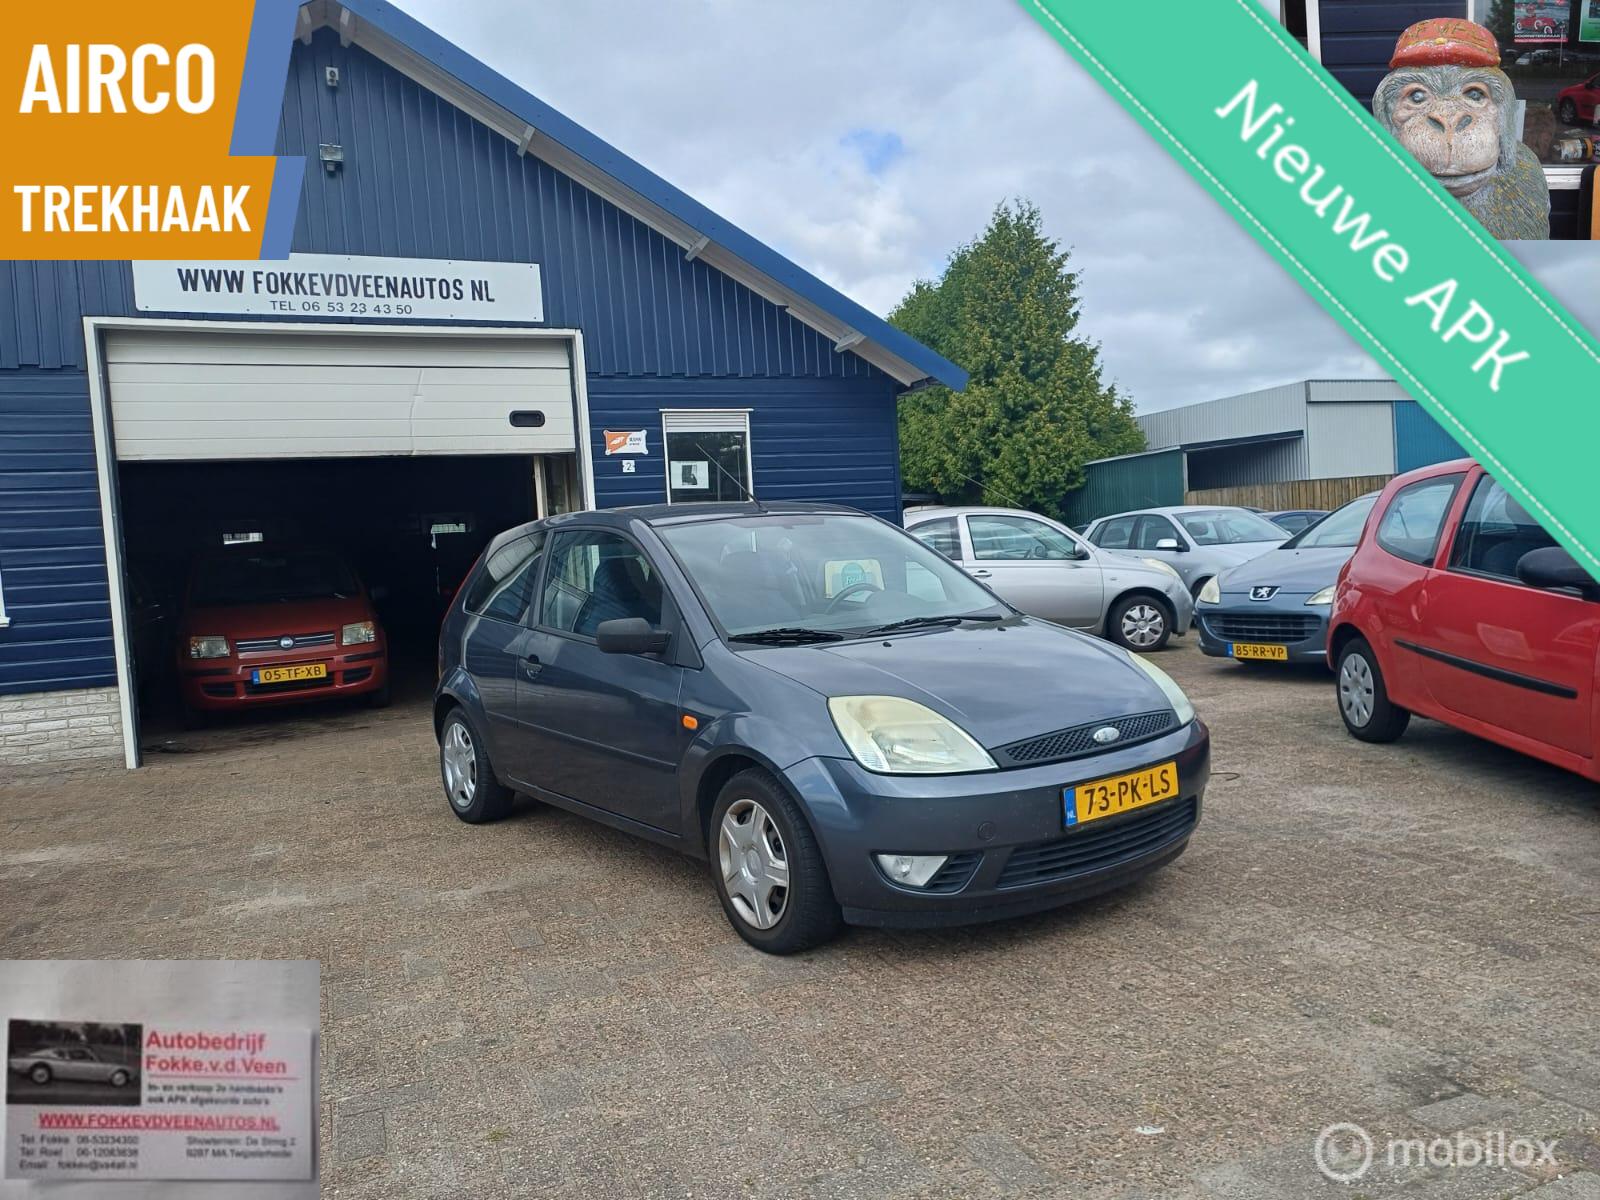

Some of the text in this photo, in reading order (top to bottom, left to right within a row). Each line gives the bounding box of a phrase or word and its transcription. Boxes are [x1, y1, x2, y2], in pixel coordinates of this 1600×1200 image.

[177, 268, 496, 303] WWW FOKKEVDVEENAUTOS NL
[270, 300, 413, 315] TEL 06 53 23 43 50
[1235, 645, 1285, 658] 85-RR-VP
[264, 666, 322, 681] 05-TF-XB
[1084, 769, 1171, 815] 73-PK-LS
